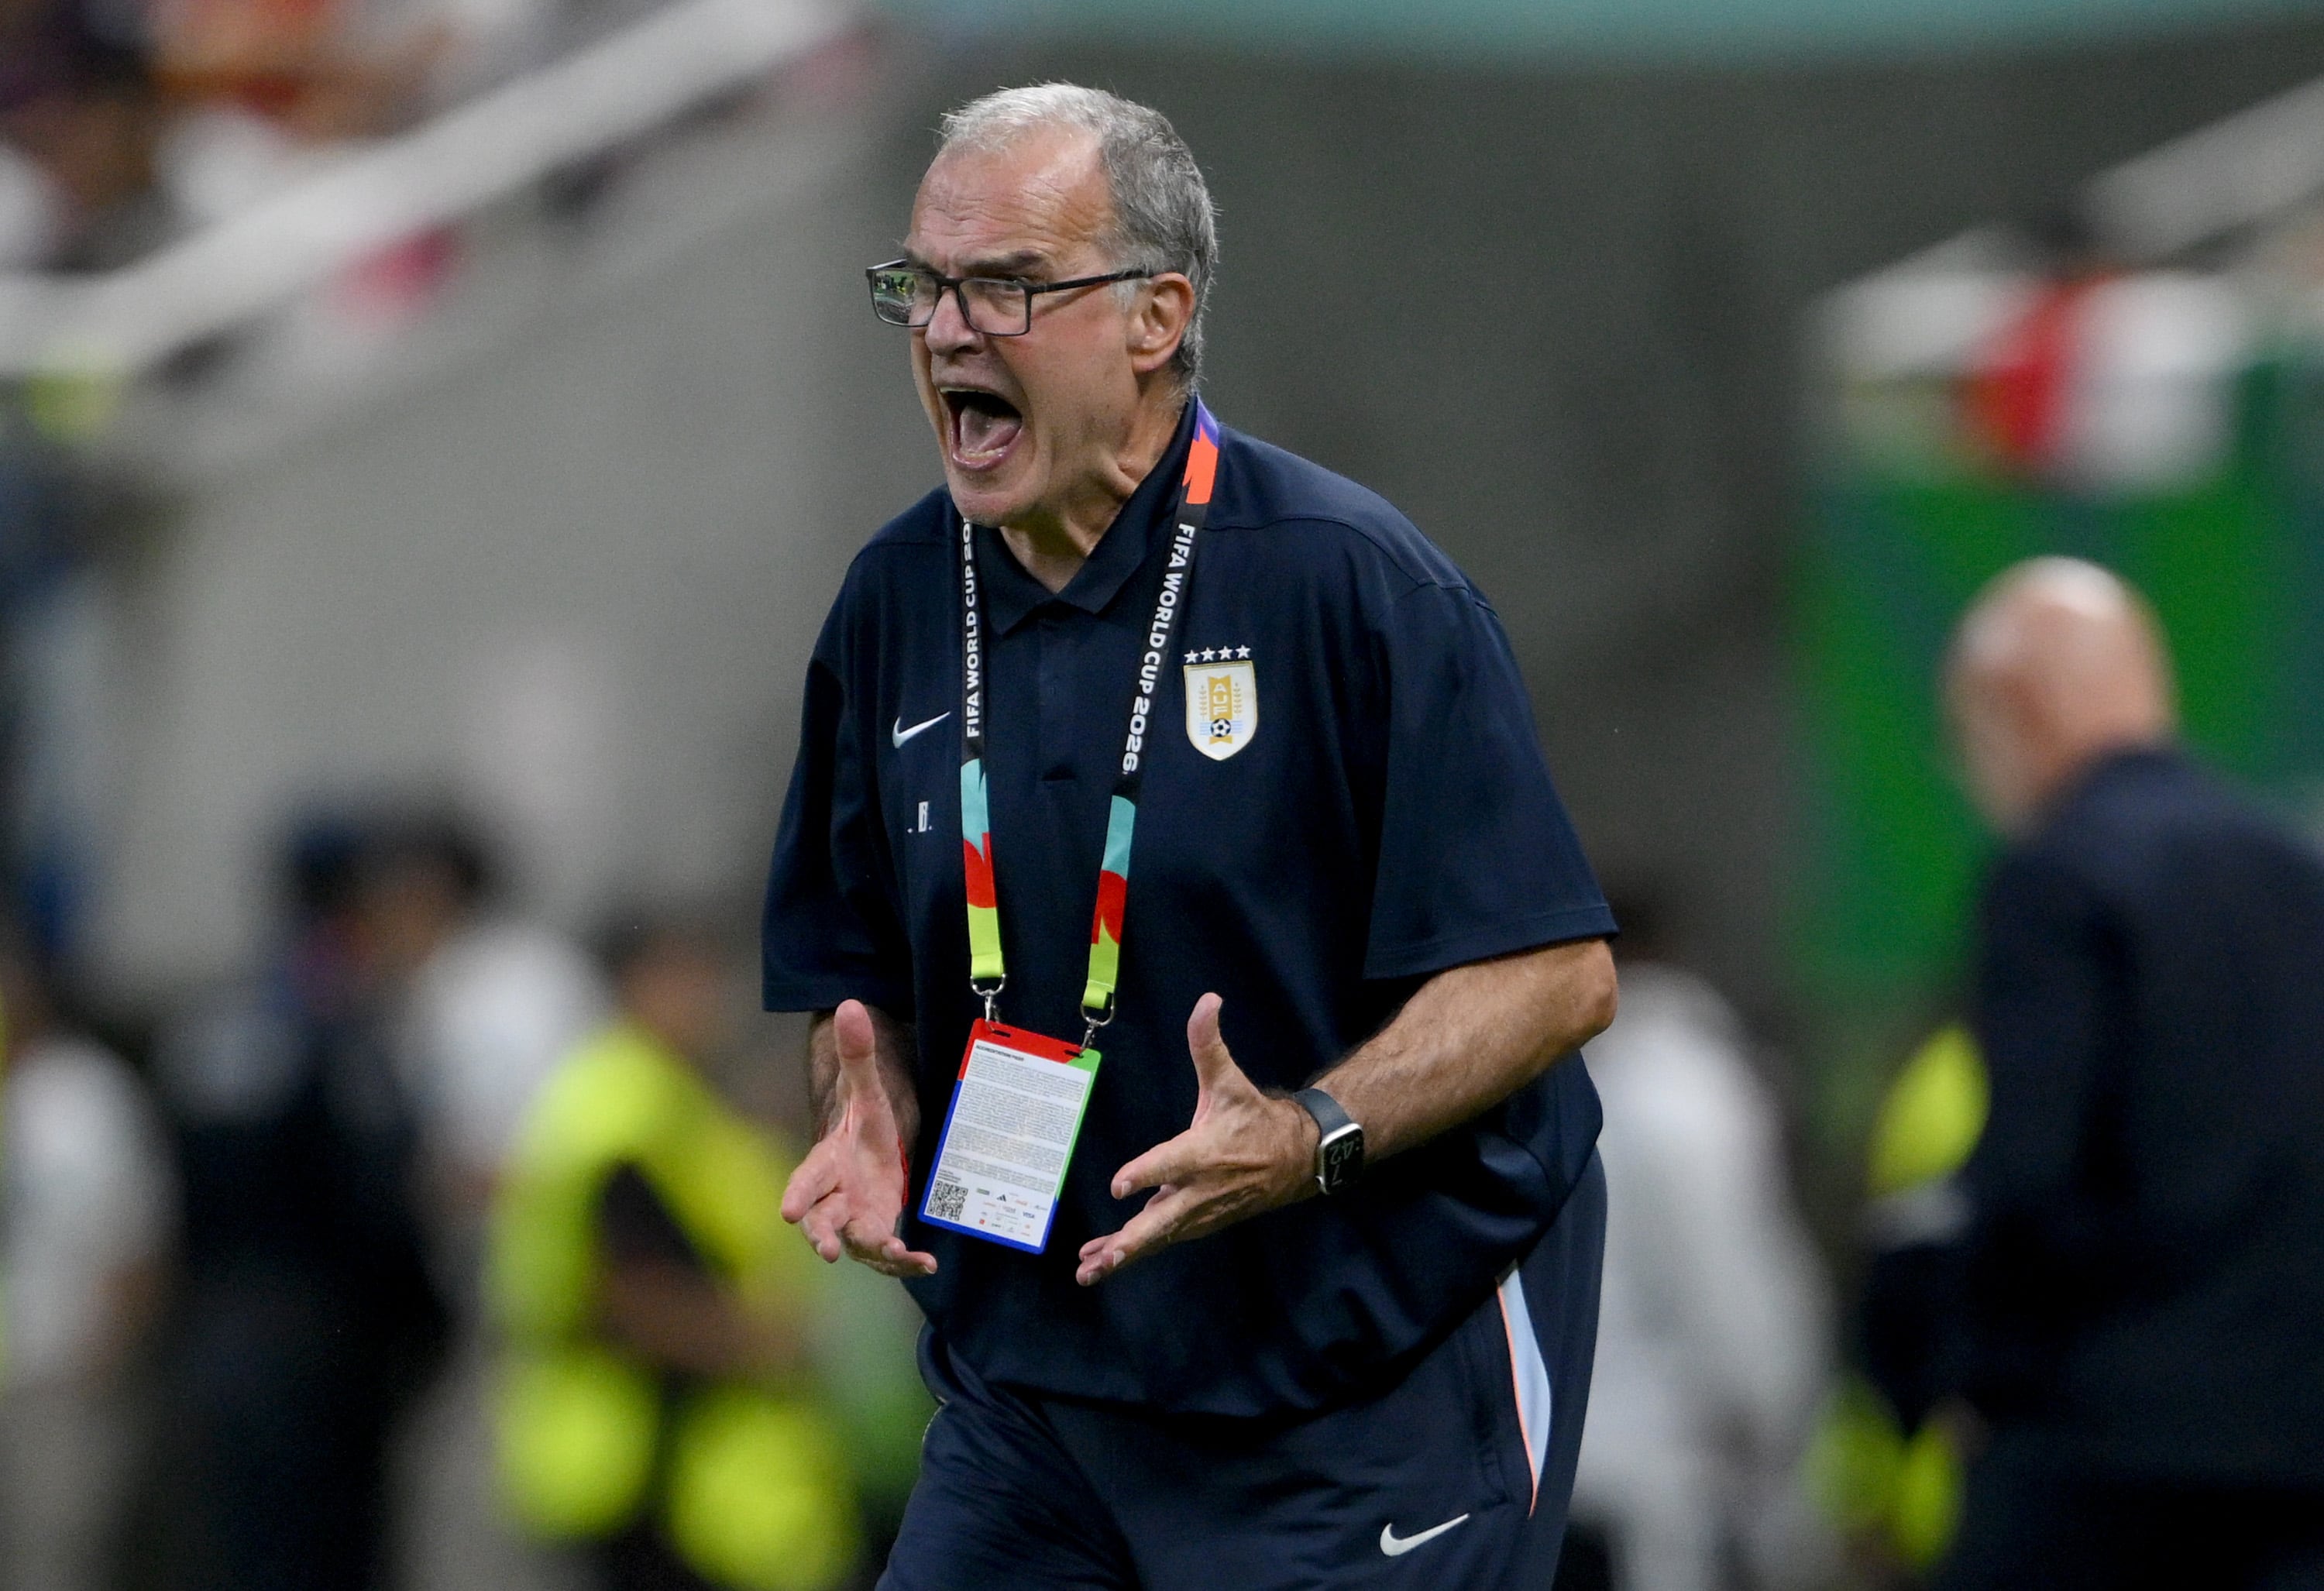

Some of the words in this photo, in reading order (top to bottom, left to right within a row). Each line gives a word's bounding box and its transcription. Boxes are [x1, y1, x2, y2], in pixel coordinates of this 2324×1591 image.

[963, 517, 972, 560] 20
[1168, 523, 1195, 568] FIFA
[965, 565, 976, 607] CUP
[1149, 572, 1183, 648] WORLD
[966, 610, 980, 689] WORLD
[1138, 651, 1161, 694] CUP
[966, 691, 980, 737] FIFA
[1122, 696, 1150, 773] 2026
